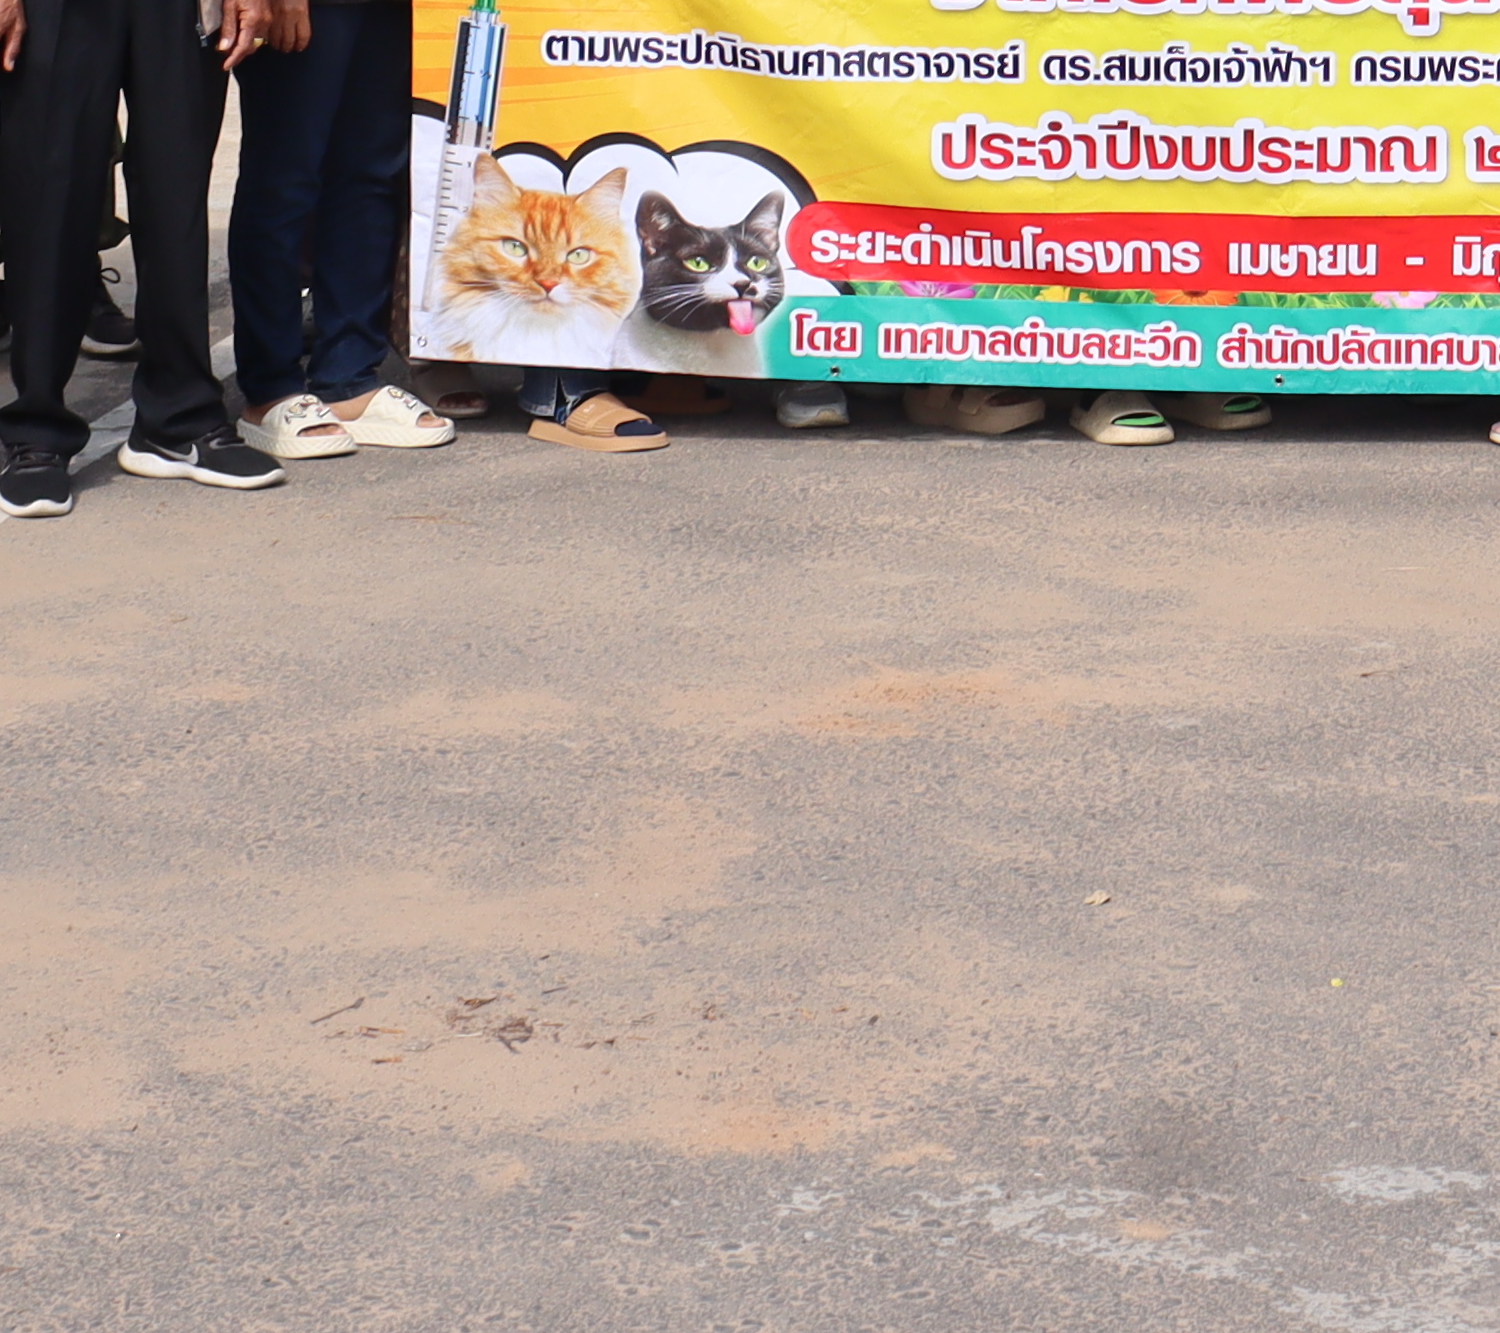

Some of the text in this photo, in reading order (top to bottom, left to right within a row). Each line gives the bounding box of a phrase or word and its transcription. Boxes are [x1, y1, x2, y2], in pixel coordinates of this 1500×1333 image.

[545, 34, 1020, 79] ตามพระปณิธานศาสตราจารย์
[1044, 45, 1331, 82] ดร.สมเด็จเจ้าฟ้าฯ
[941, 120, 1438, 174] ประจำปีงบประมาณ
[809, 223, 1202, 276] ระยะดำเนินโครงการ
[1228, 243, 1378, 277] เมษายน
[794, 313, 857, 353] โดย
[883, 321, 1197, 361] เทศบาลตำบลยะวึก
